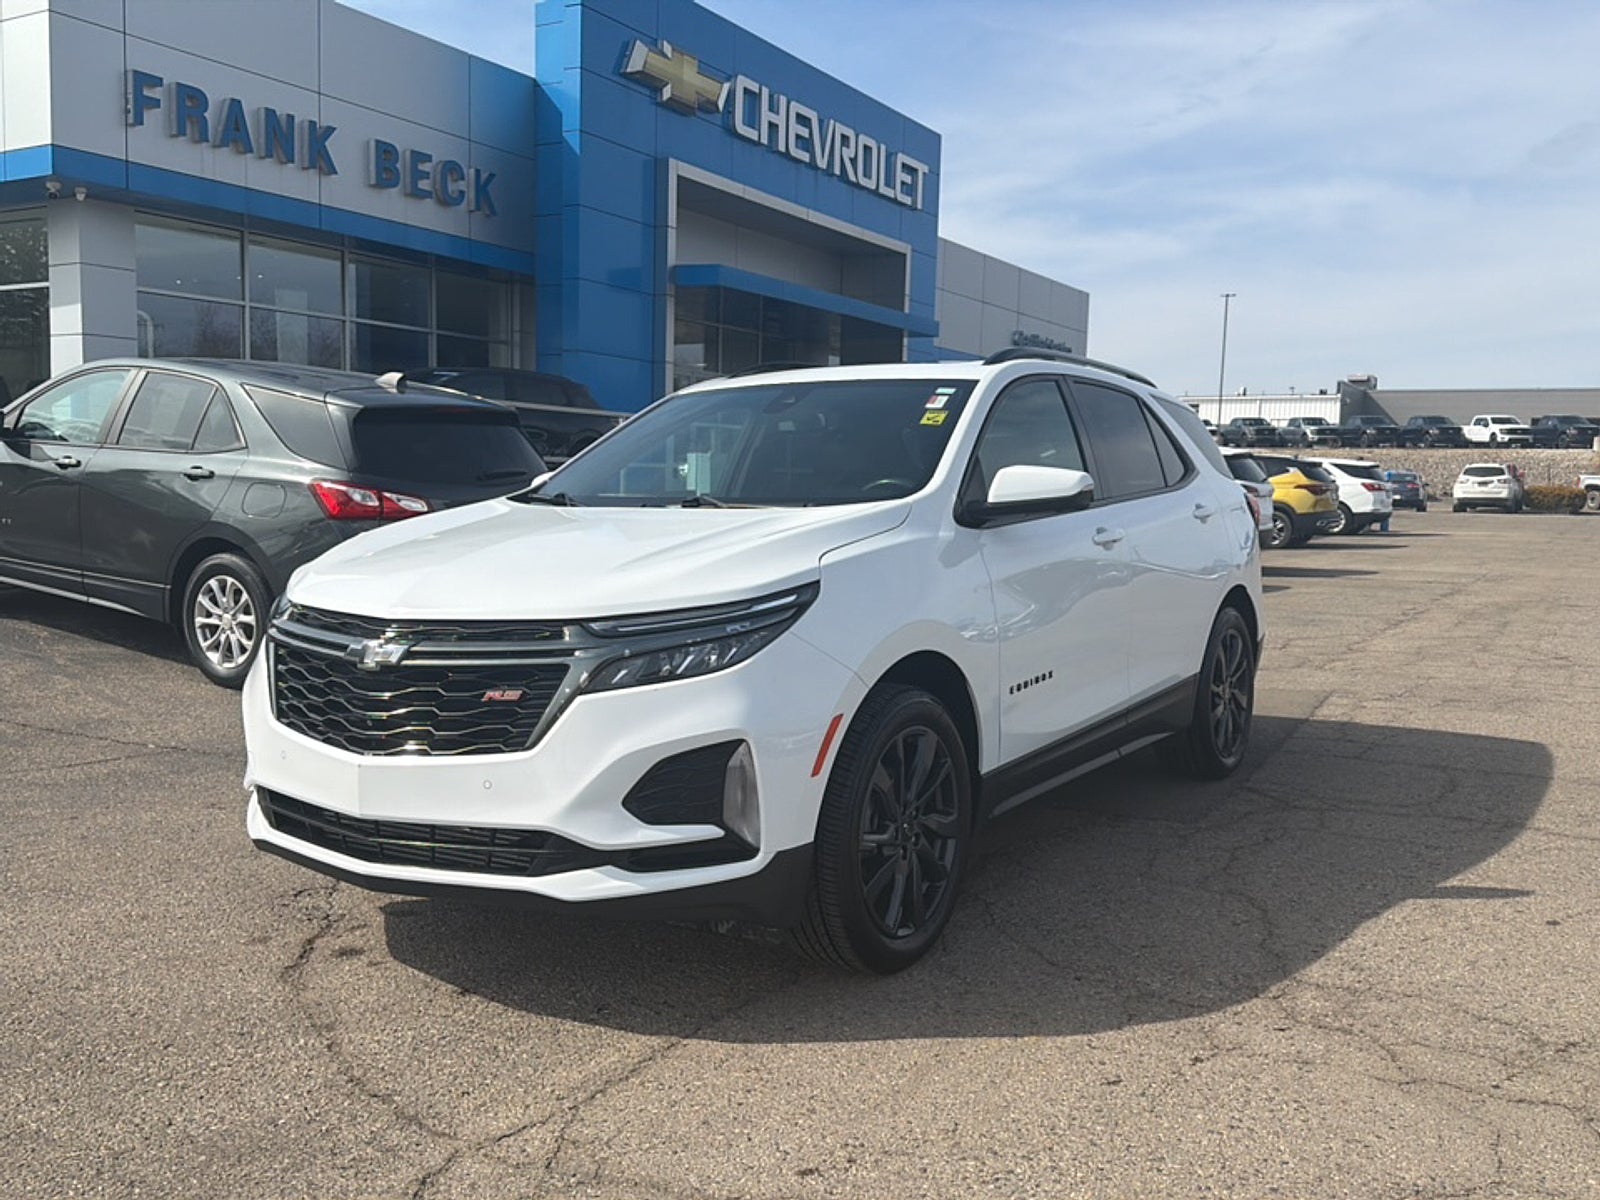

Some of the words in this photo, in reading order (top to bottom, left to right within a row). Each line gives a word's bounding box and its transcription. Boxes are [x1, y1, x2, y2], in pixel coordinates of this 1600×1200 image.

[127, 68, 338, 175] FRANK
[368, 138, 498, 216] BECK
[734, 73, 930, 210] CHEVROLET
[1009, 669, 1054, 695] EQUINOX
